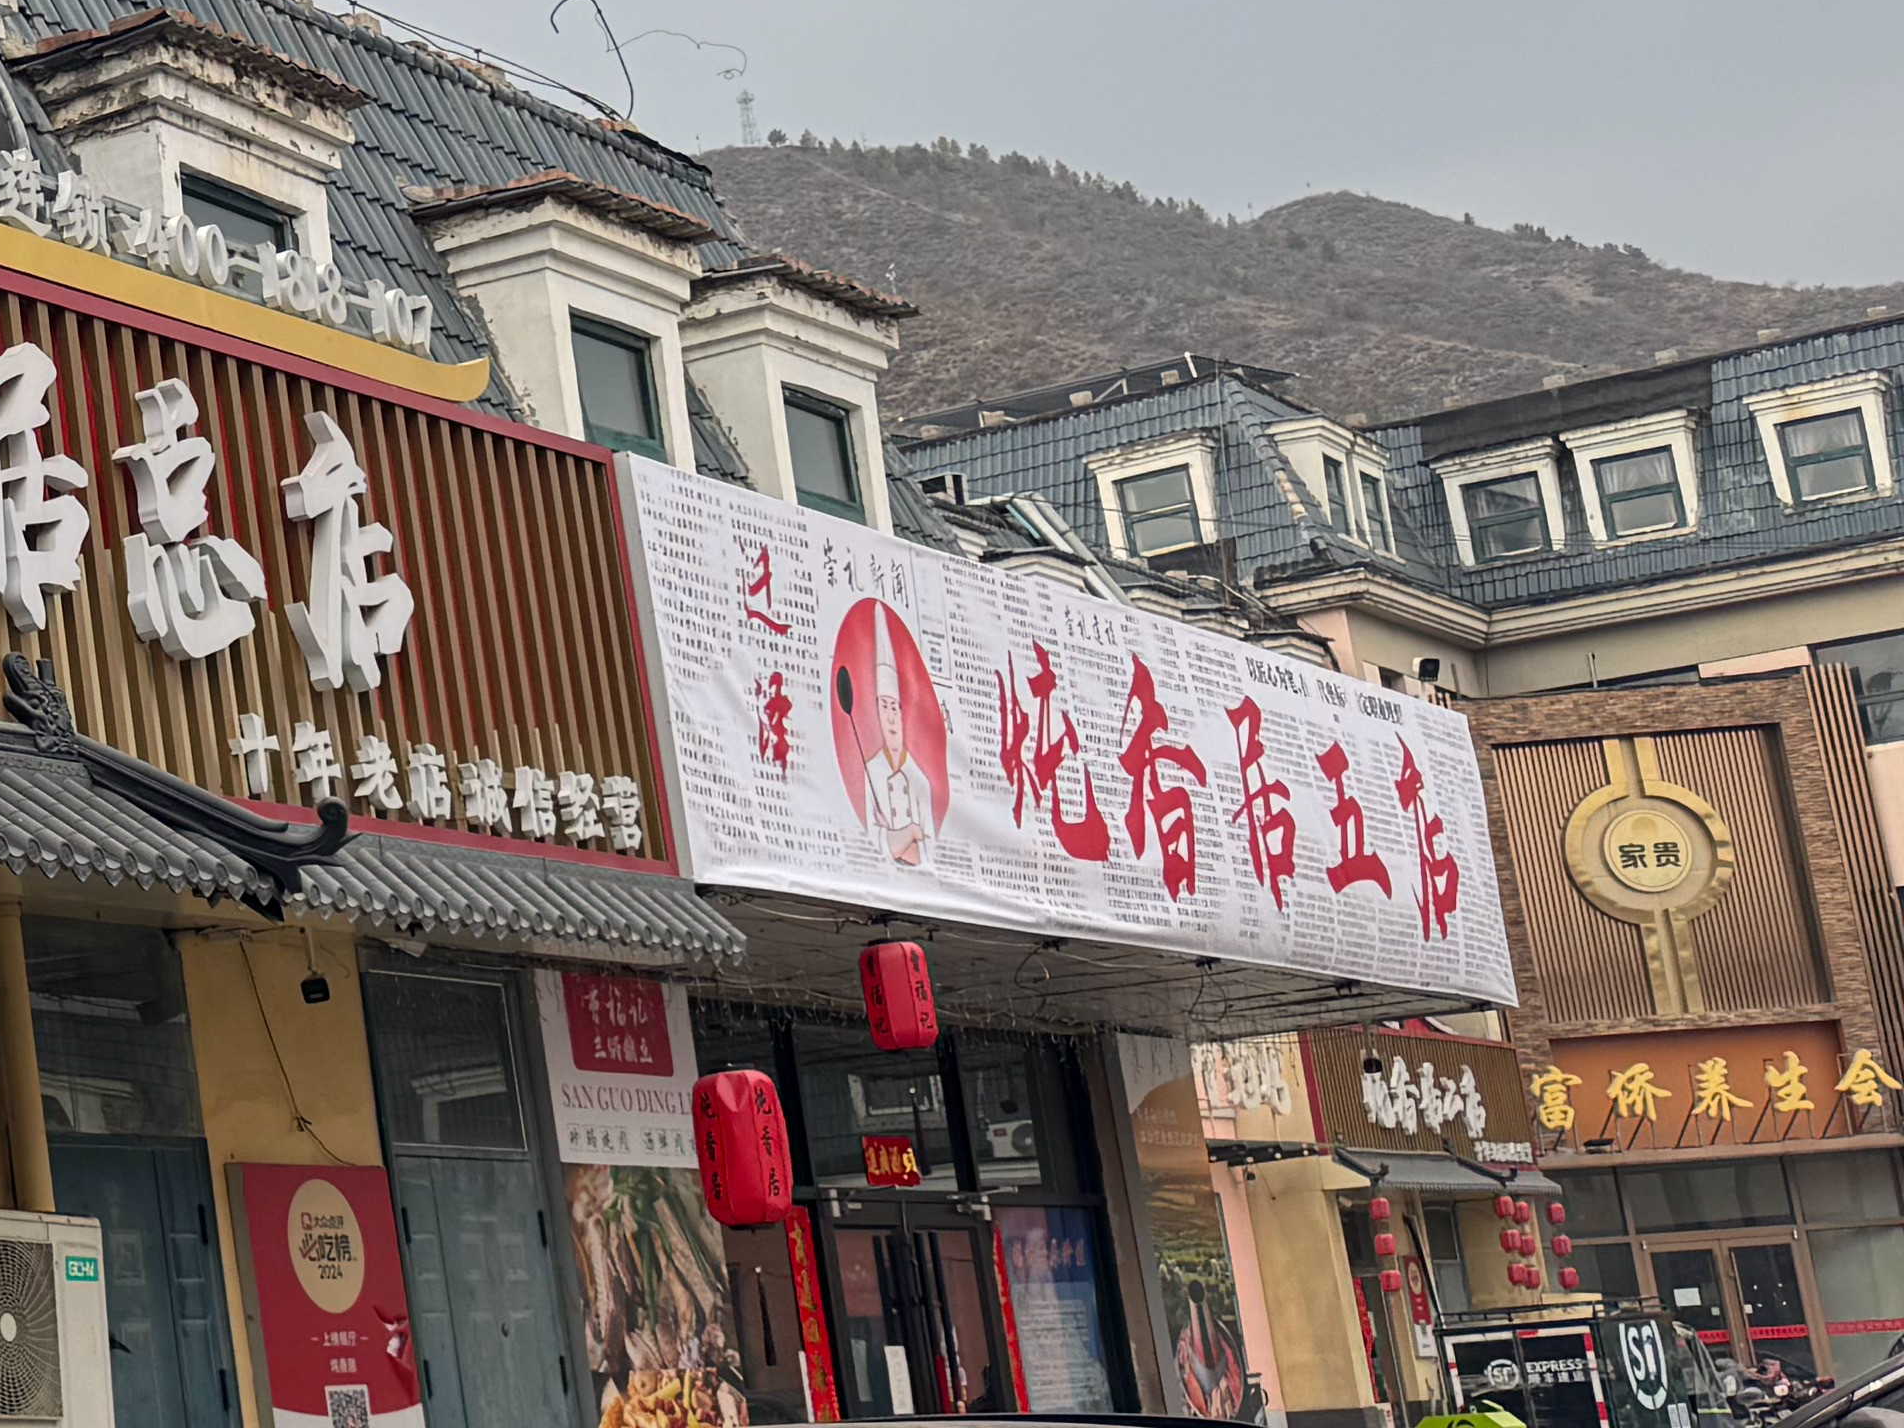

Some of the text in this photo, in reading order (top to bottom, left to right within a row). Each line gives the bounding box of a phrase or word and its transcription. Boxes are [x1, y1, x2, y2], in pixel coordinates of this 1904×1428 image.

[995, 639, 1459, 942] 炖香居五店
[562, 1083, 594, 1109] SAN
[597, 1086, 632, 1113] GUO
[636, 1089, 677, 1114] DING
[1531, 1049, 1902, 1130] 富侨养生会
[298, 1232, 353, 1262] 必吃榜
[317, 1264, 344, 1280] 2024
[1525, 1358, 1584, 1373] EXPRESS
